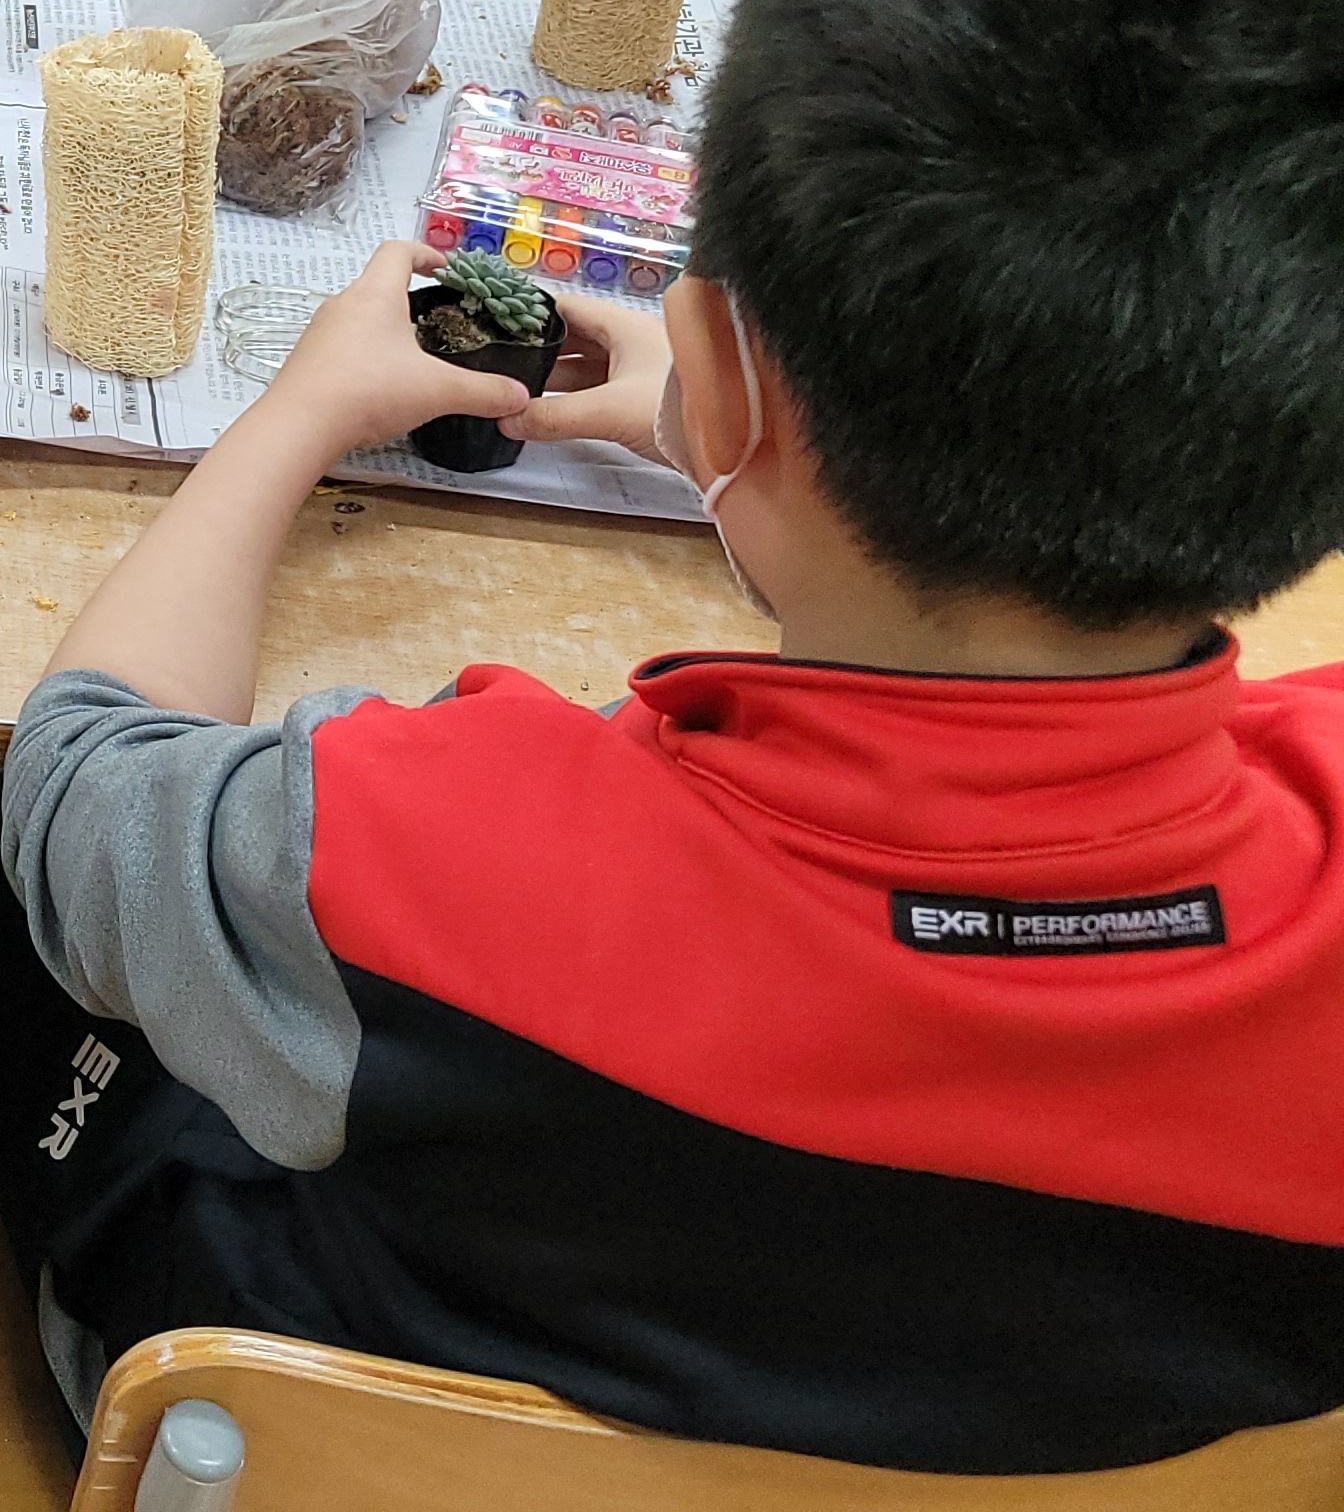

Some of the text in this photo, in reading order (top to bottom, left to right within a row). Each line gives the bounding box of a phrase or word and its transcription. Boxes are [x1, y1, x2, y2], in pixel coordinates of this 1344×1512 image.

[911, 906, 989, 940] EXR
[1013, 901, 1210, 936] PERFORMANCE
[38, 1033, 121, 1160] EXR
